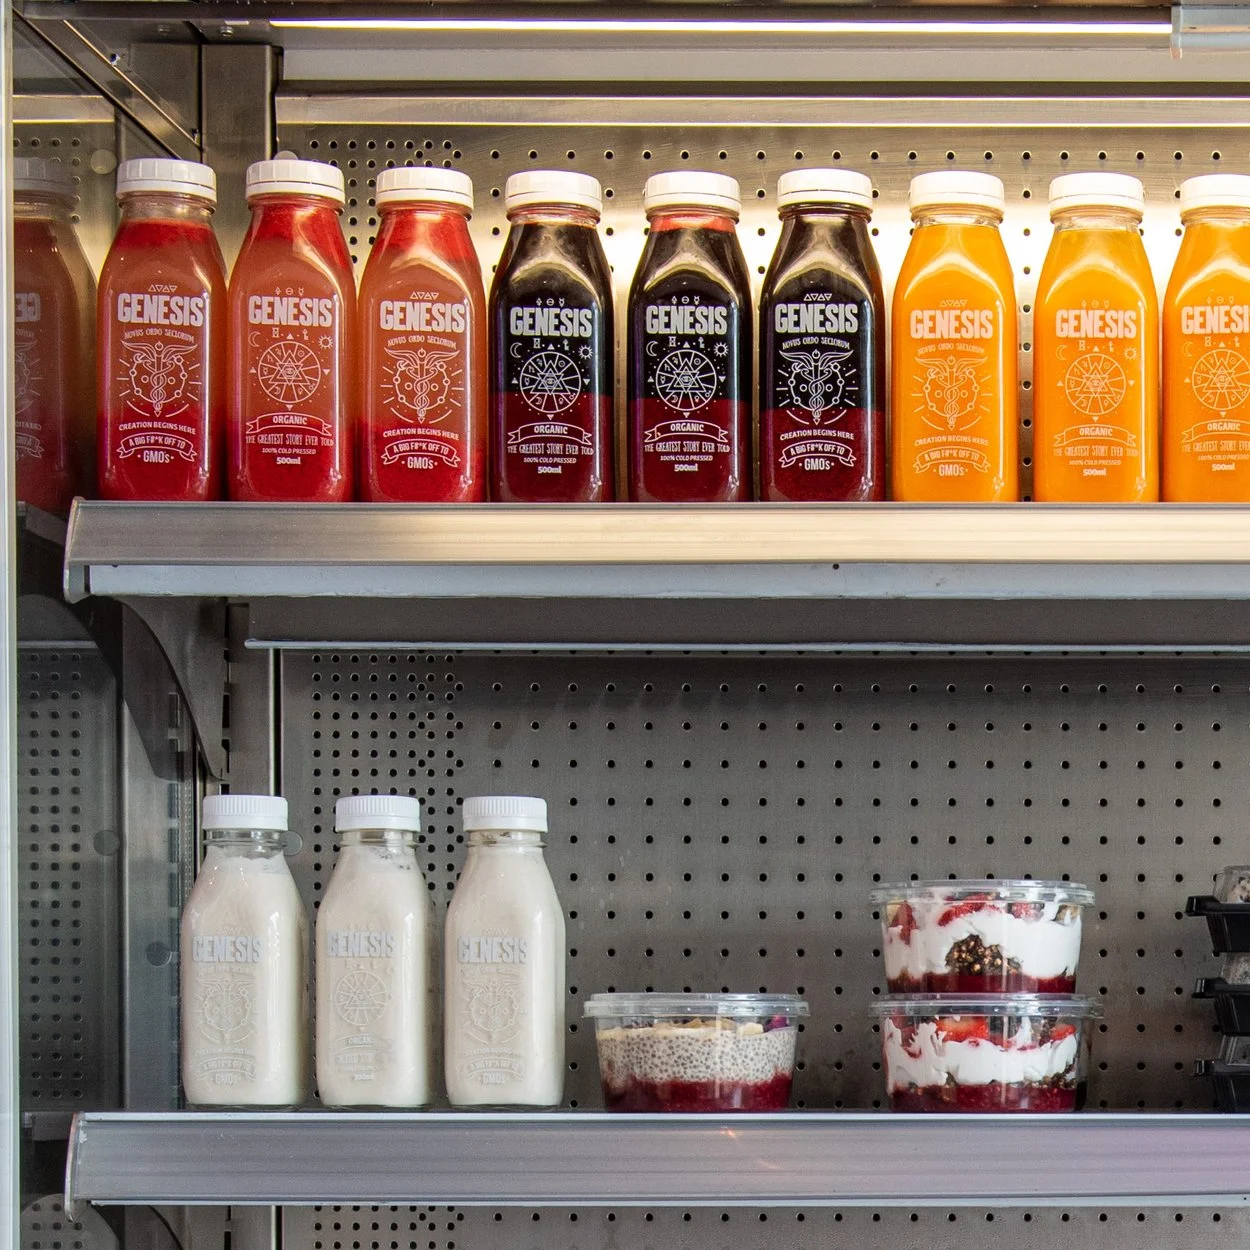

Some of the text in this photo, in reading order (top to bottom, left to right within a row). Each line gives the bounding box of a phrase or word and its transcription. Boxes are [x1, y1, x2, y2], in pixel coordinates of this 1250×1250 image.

[118, 294, 203, 326] GENESIS
[248, 296, 332, 326] GENESIS
[380, 302, 464, 332] GENESIS
[510, 308, 592, 337] GENESIS
[646, 304, 727, 334] GENESIS
[775, 304, 858, 333] GENESIS
[910, 310, 992, 338] GENESIS
[1056, 310, 1136, 338] GENESIS
[273, 415, 307, 424] ORGANIC
[119, 422, 195, 435] CREATION BEGINS HERE
[535, 425, 568, 434] ORGANIC
[671, 423, 704, 431] ORGANIC
[1080, 427, 1113, 436] ORGANIC
[1207, 422, 1241, 431] ORGANIC
[246, 435, 255, 444] THE
[258, 433, 284, 444] GREATEST
[286, 434, 303, 445] STORY
[305, 436, 319, 445] EVER
[383, 429, 416, 438] CREATION
[442, 431, 459, 440] HERE
[780, 430, 812, 440] CREATION
[838, 431, 854, 440] HERE
[129, 439, 135, 447] A
[135, 437, 145, 445] BIG
[164, 437, 176, 445] OFF
[177, 440, 185, 449] TO
[428, 443, 440, 451] OFF
[441, 446, 449, 455] TO
[508, 445, 517, 453] THE
[519, 443, 545, 454] GREATEST
[547, 444, 564, 455] STORY
[566, 445, 579, 455] EVER
[645, 444, 654, 452] THE
[656, 441, 681, 452] GREATEST
[683, 441, 700, 452] STORY
[702, 443, 715, 452] EVER
[824, 444, 835, 452] OFF
[836, 446, 845, 455] TO
[276, 456, 301, 465] 500ml
[1212, 462, 1235, 471] 500ml
[538, 465, 562, 474] 500ml
[674, 463, 698, 471] 500ml
[1083, 468, 1106, 476] 500ml
[193, 935, 263, 962] GENESIS
[327, 931, 396, 957] GENESIS
[459, 936, 528, 964] GENESIS
